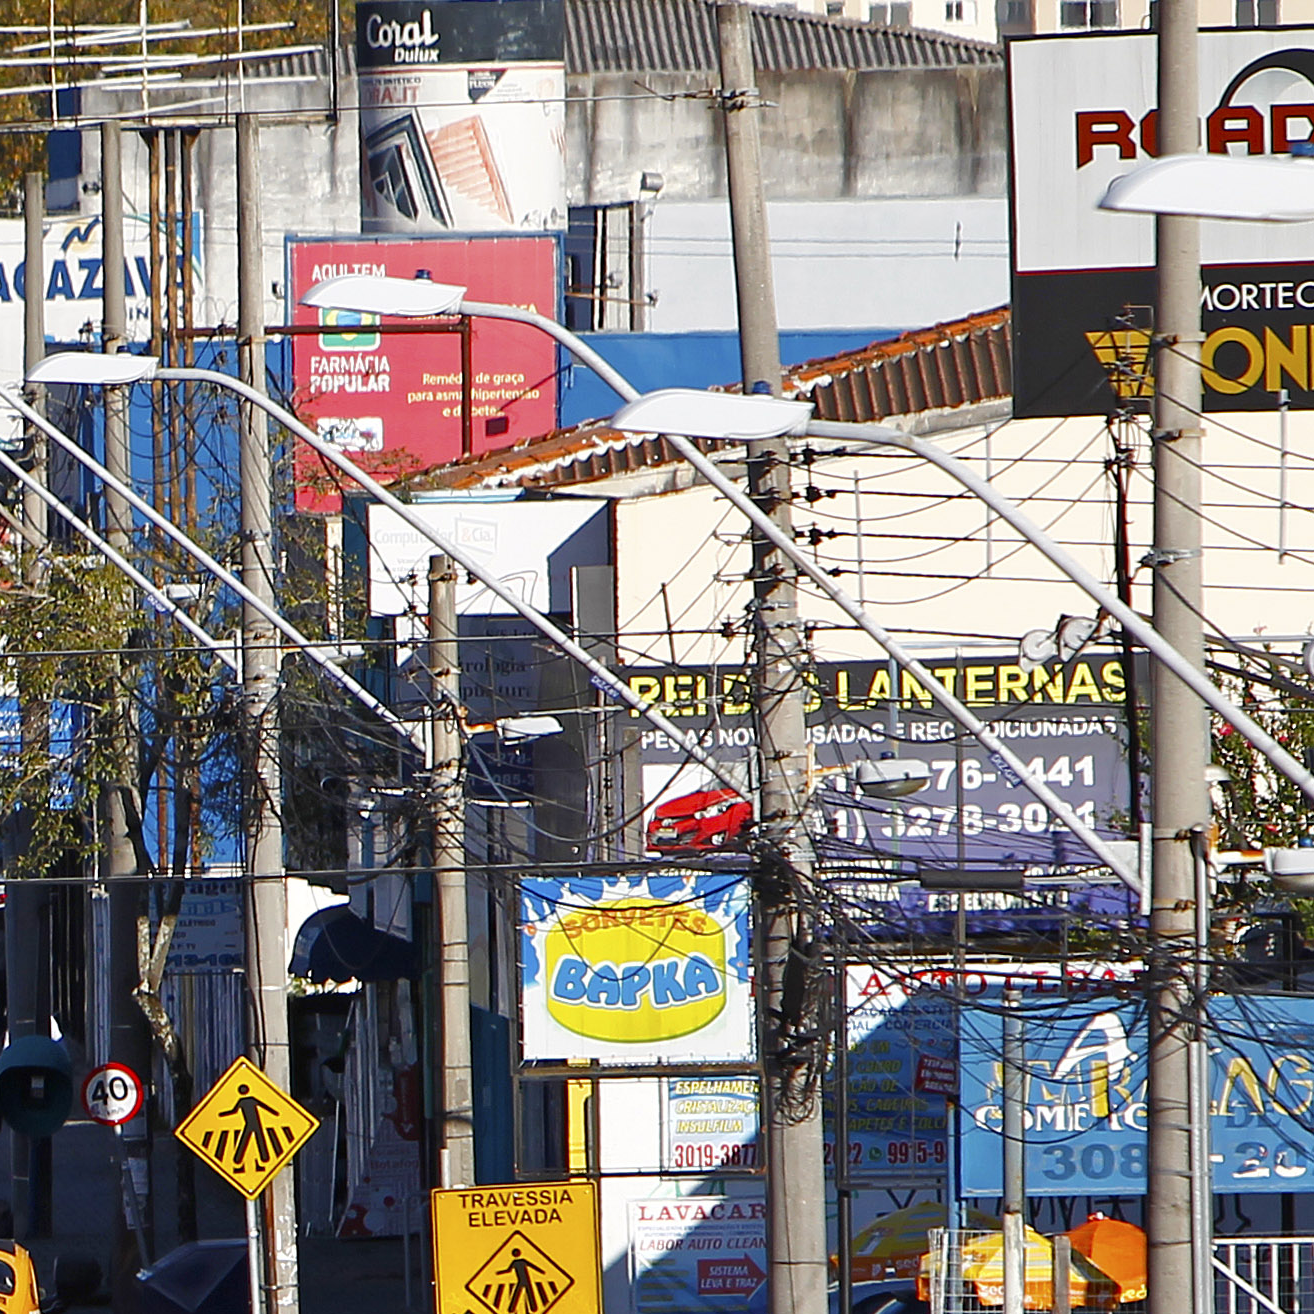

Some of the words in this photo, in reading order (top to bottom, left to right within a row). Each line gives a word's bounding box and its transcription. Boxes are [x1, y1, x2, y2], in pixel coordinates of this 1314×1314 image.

[367, 9, 439, 48] Coral
[394, 47, 439, 62] Dulux
[310, 354, 390, 374] FARMÁCIA
[310, 375, 390, 393] POPULAR
[422, 372, 466, 386] Reméd
[476, 373, 490, 384] de
[493, 374, 525, 390] graça
[407, 391, 434, 405] para
[628, 674, 707, 718] REI
[723, 670, 822, 716] DS
[837, 660, 1127, 712] LANTERNAS
[911, 716, 1117, 743] RECDICIONADAS
[562, 907, 708, 940] SORVETES
[554, 954, 721, 1007] BAPKA
[91, 1076, 129, 1105] 40
[675, 1118, 744, 1134] INSULFILM
[1042, 1144, 1148, 1181] 308
[458, 1189, 573, 1208] TRAVESSIA
[468, 1208, 562, 1228] ELEVADA
[638, 1202, 768, 1221] LAVACAR
[639, 1239, 683, 1251] LABOR
[687, 1238, 723, 1251] AUTO
[709, 1265, 748, 1276] SISTEMA
[700, 1278, 723, 1289] LEVA
[734, 1278, 758, 1289] TRAZ
